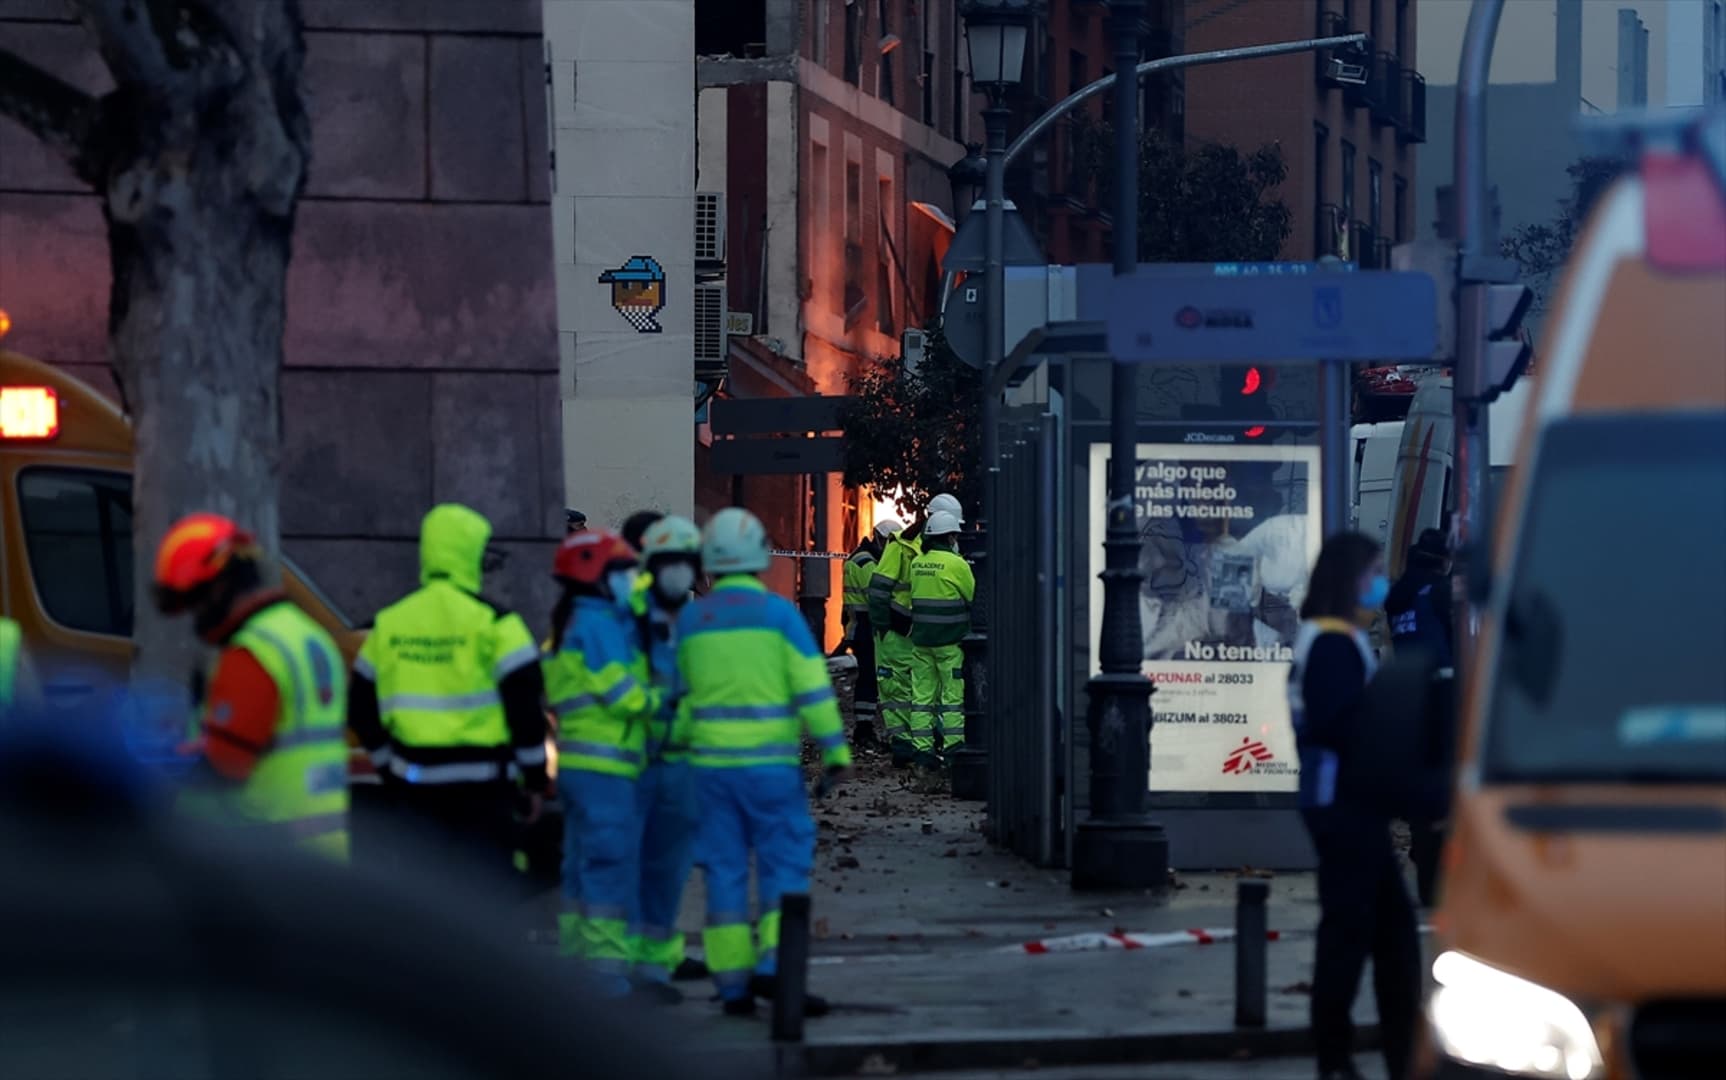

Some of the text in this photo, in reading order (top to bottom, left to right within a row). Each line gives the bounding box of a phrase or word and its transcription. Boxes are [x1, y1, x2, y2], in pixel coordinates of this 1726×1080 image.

[1184, 432, 1235, 442] JCDecaux
[1135, 462, 1227, 484] y algo que
[1135, 483, 1237, 500] más miedo
[1135, 500, 1254, 518] e las vacunas
[1184, 641, 1293, 660] No tenerla
[1147, 672, 1254, 684] ACUNAR al 28033
[1198, 712, 1210, 723] al
[1213, 713, 1248, 724] 38021
